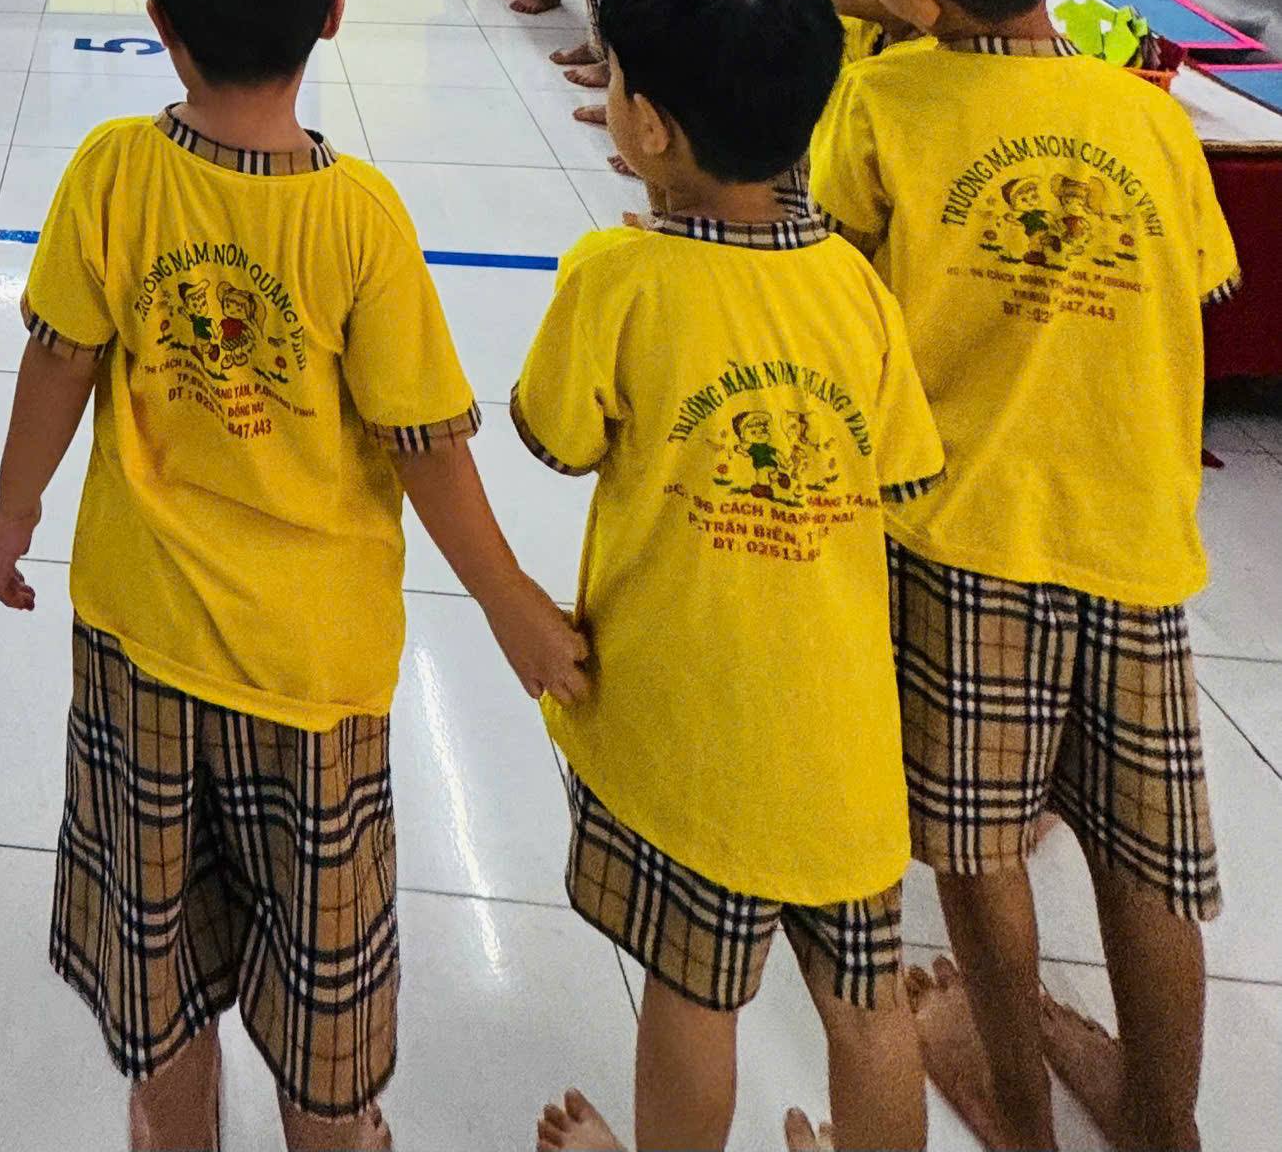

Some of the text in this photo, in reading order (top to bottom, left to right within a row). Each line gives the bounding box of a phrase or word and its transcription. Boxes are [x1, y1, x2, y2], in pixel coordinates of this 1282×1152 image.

[1034, 134, 1076, 160] NON
[214, 243, 249, 271] NON
[249, 264, 299, 325] QUANG
